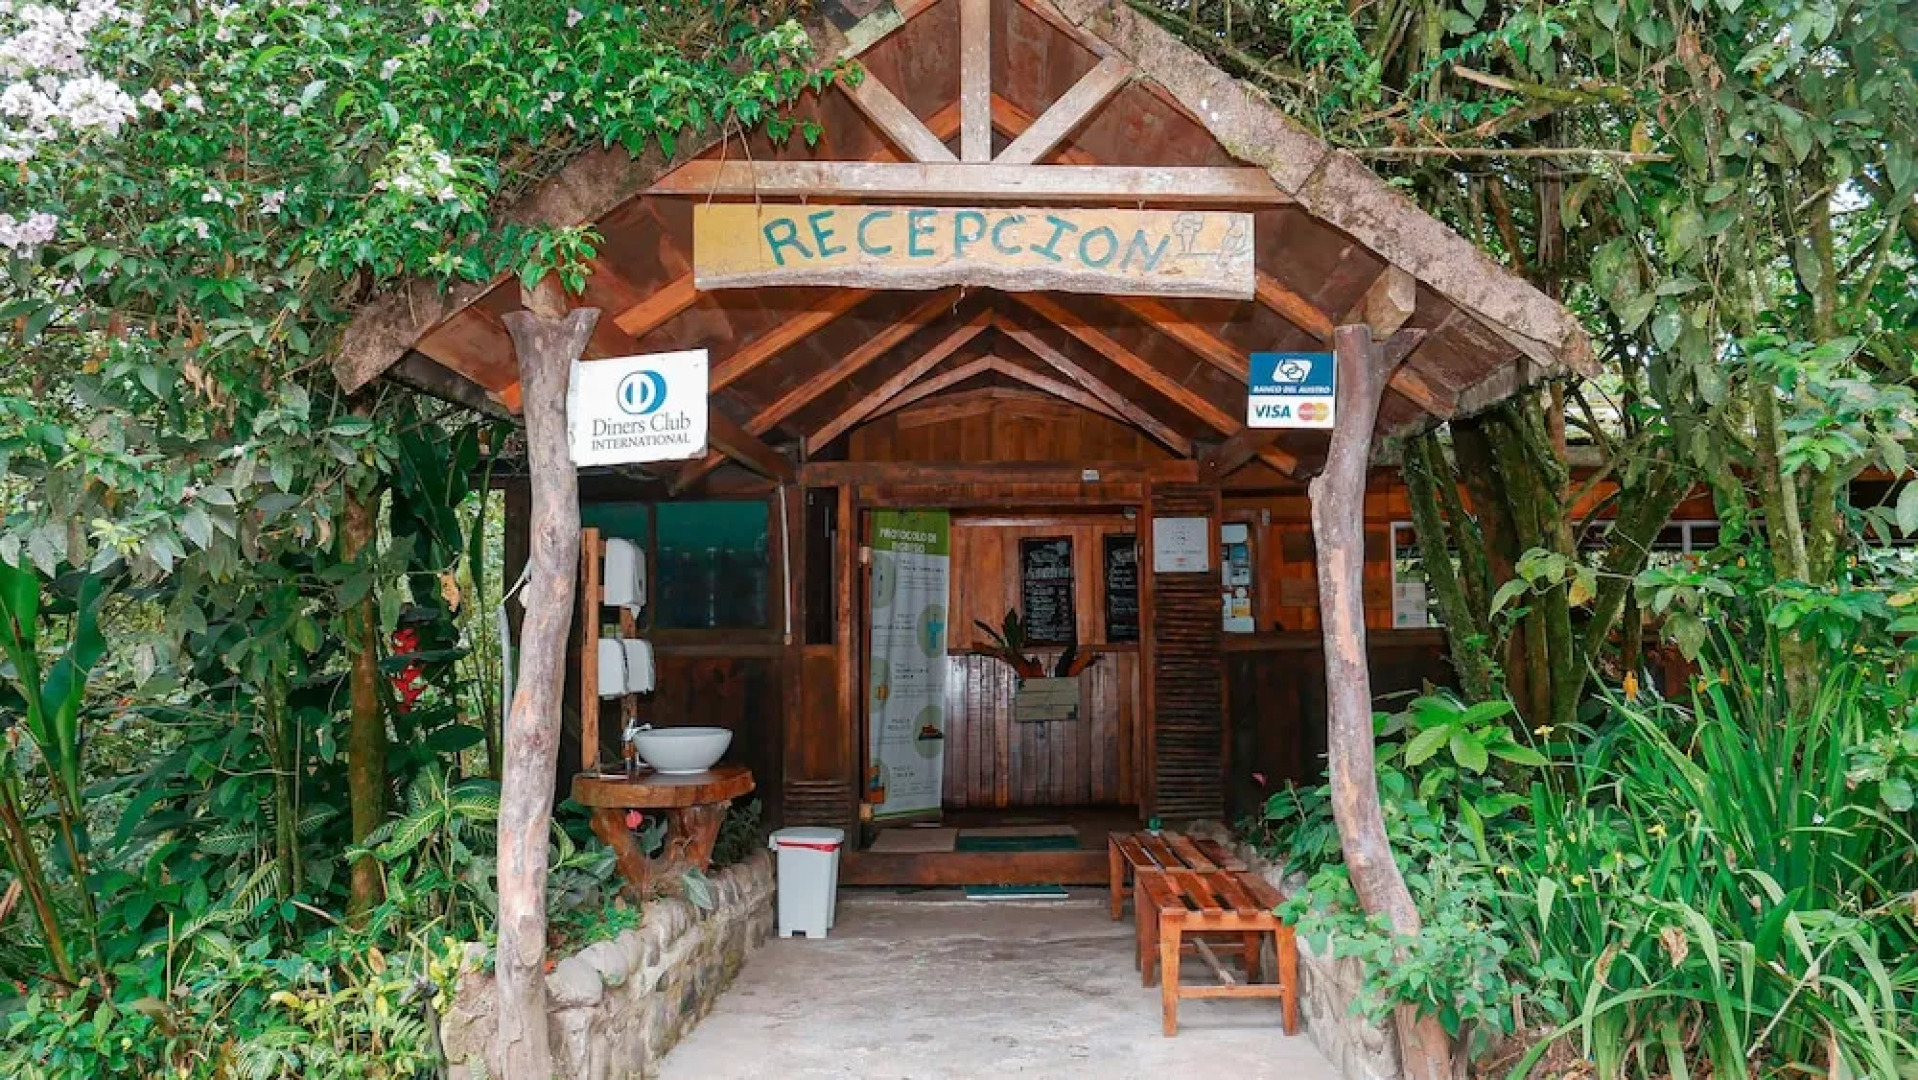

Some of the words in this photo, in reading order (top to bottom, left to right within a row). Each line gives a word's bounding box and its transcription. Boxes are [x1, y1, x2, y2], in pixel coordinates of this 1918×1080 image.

[762, 209, 1171, 272] RECEPCION
[1255, 404, 1291, 419] VISA
[592, 418, 645, 437] Diners
[649, 410, 691, 432] Club
[591, 433, 691, 451] INTERNATIONAL
